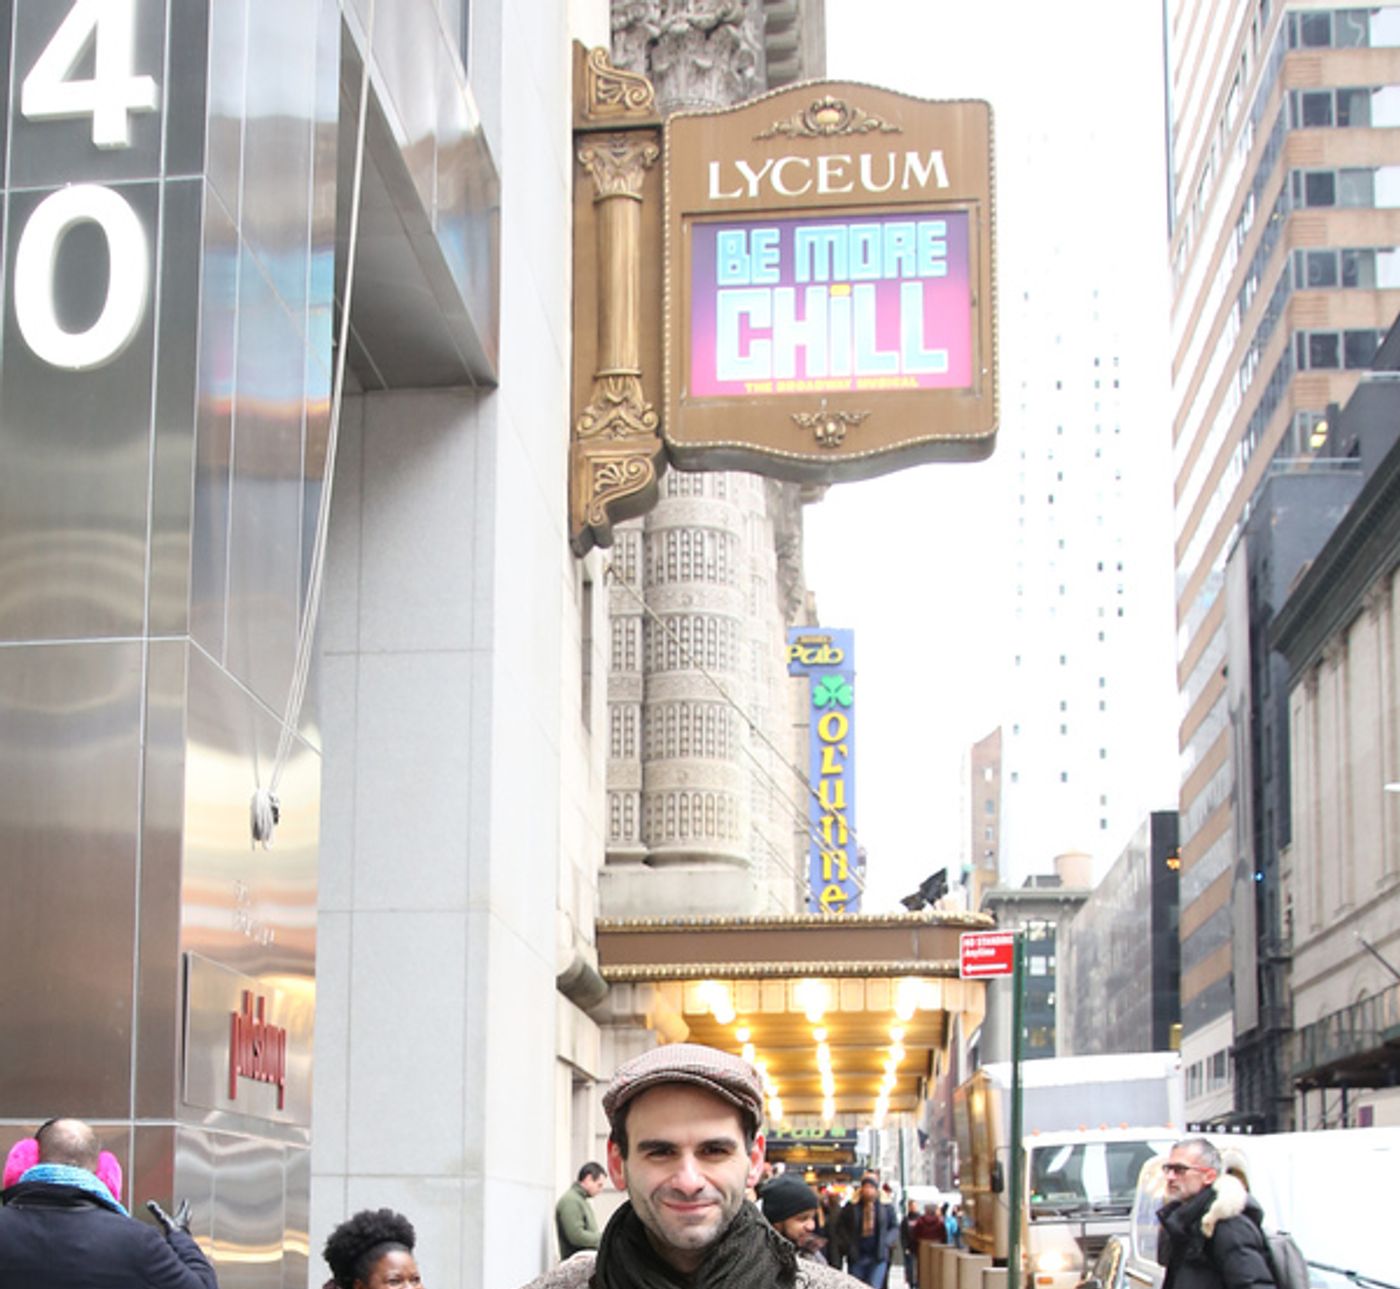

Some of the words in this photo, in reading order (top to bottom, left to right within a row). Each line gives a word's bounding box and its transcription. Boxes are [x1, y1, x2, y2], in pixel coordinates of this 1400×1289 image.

[708, 150, 950, 200] LYCEUM
[716, 228, 780, 286] BE
[794, 220, 947, 283] MORE
